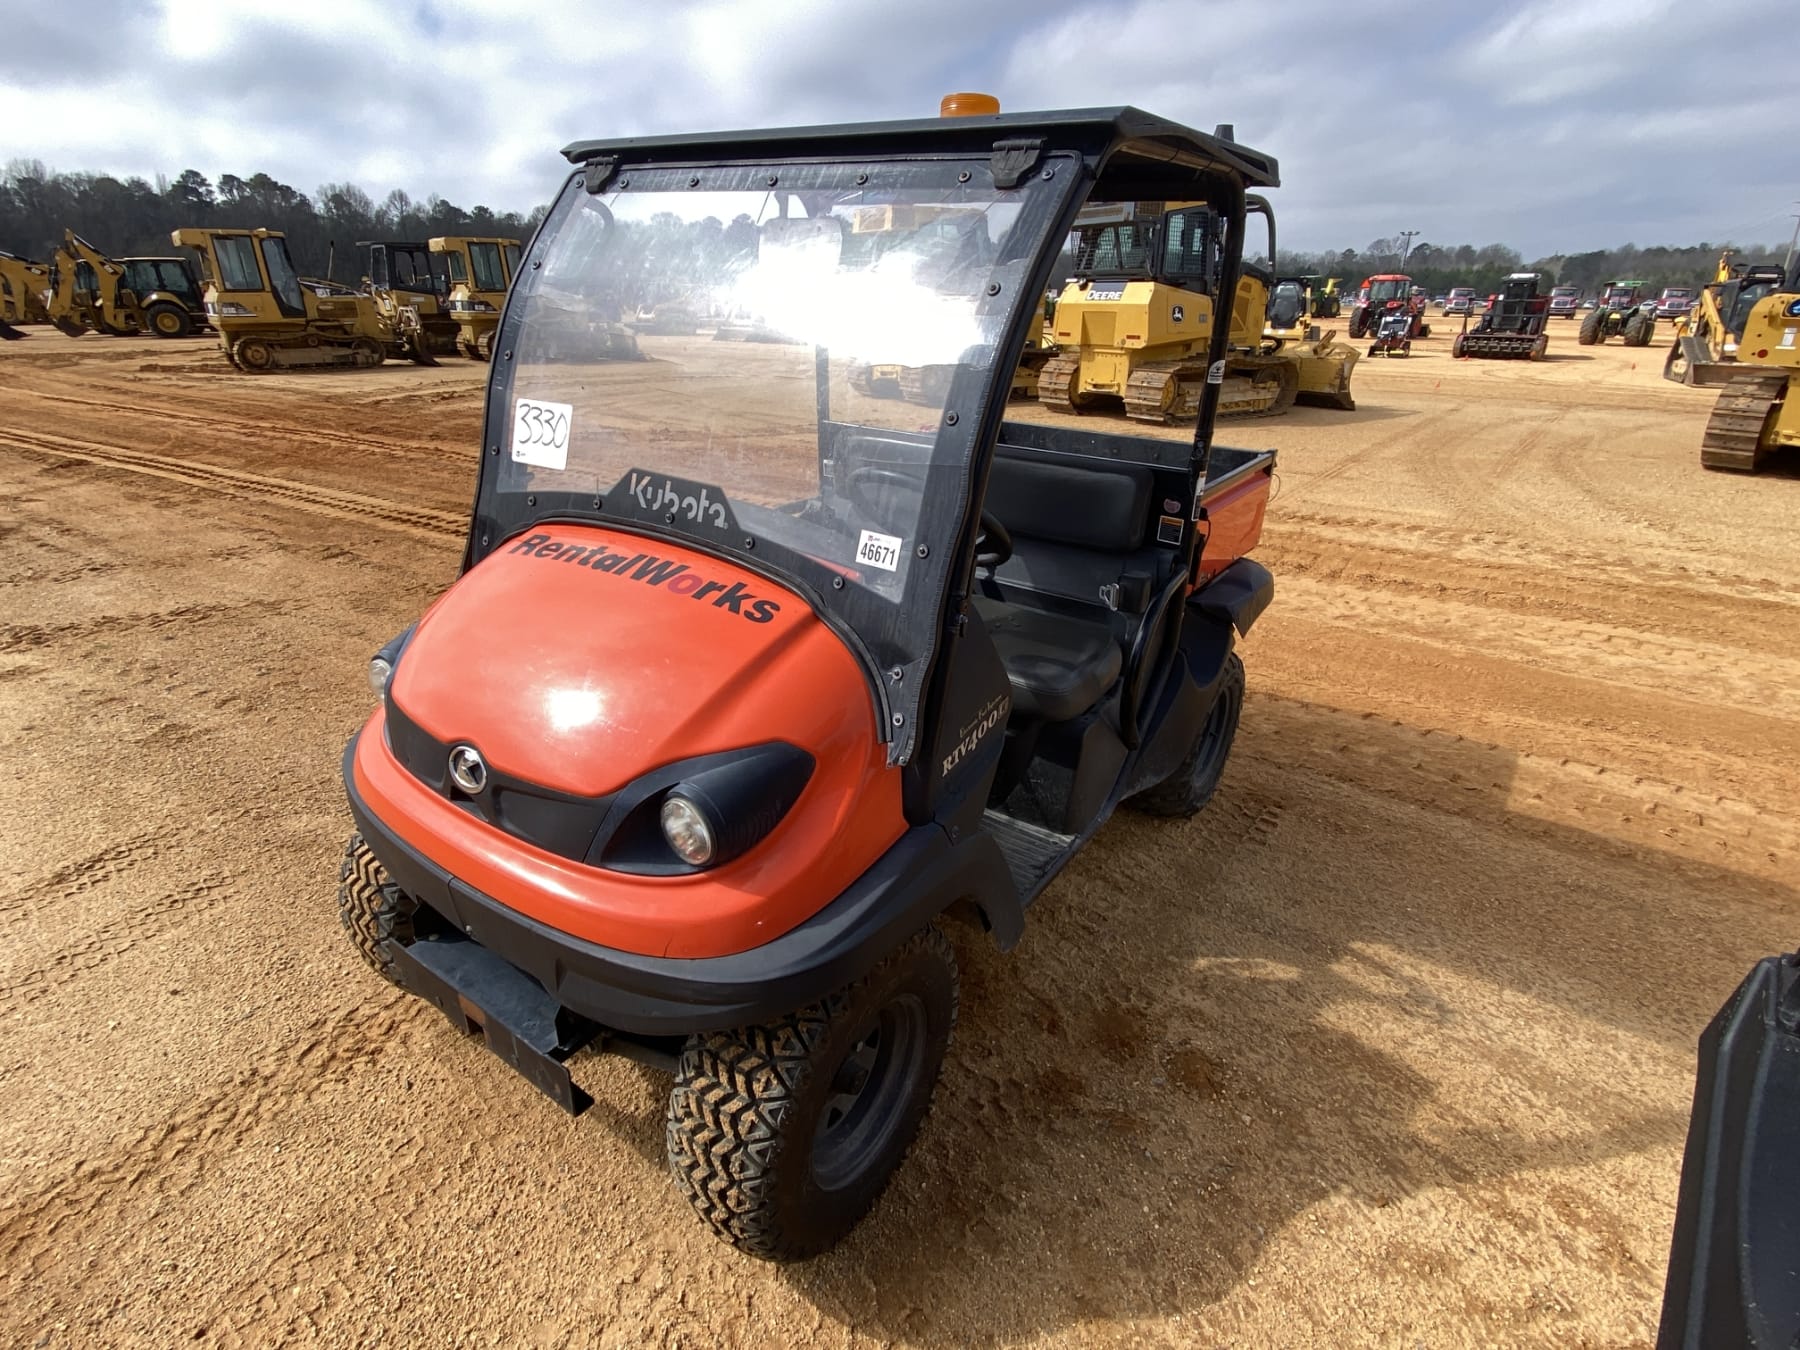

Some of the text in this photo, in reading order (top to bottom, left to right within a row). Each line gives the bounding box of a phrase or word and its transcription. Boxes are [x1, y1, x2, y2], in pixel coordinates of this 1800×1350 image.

[1086, 290, 1122, 300] DEERE
[519, 403, 568, 449] 3330
[629, 473, 726, 528] Kubota
[860, 542, 896, 566] 46671
[507, 534, 781, 623] RentalWorks
